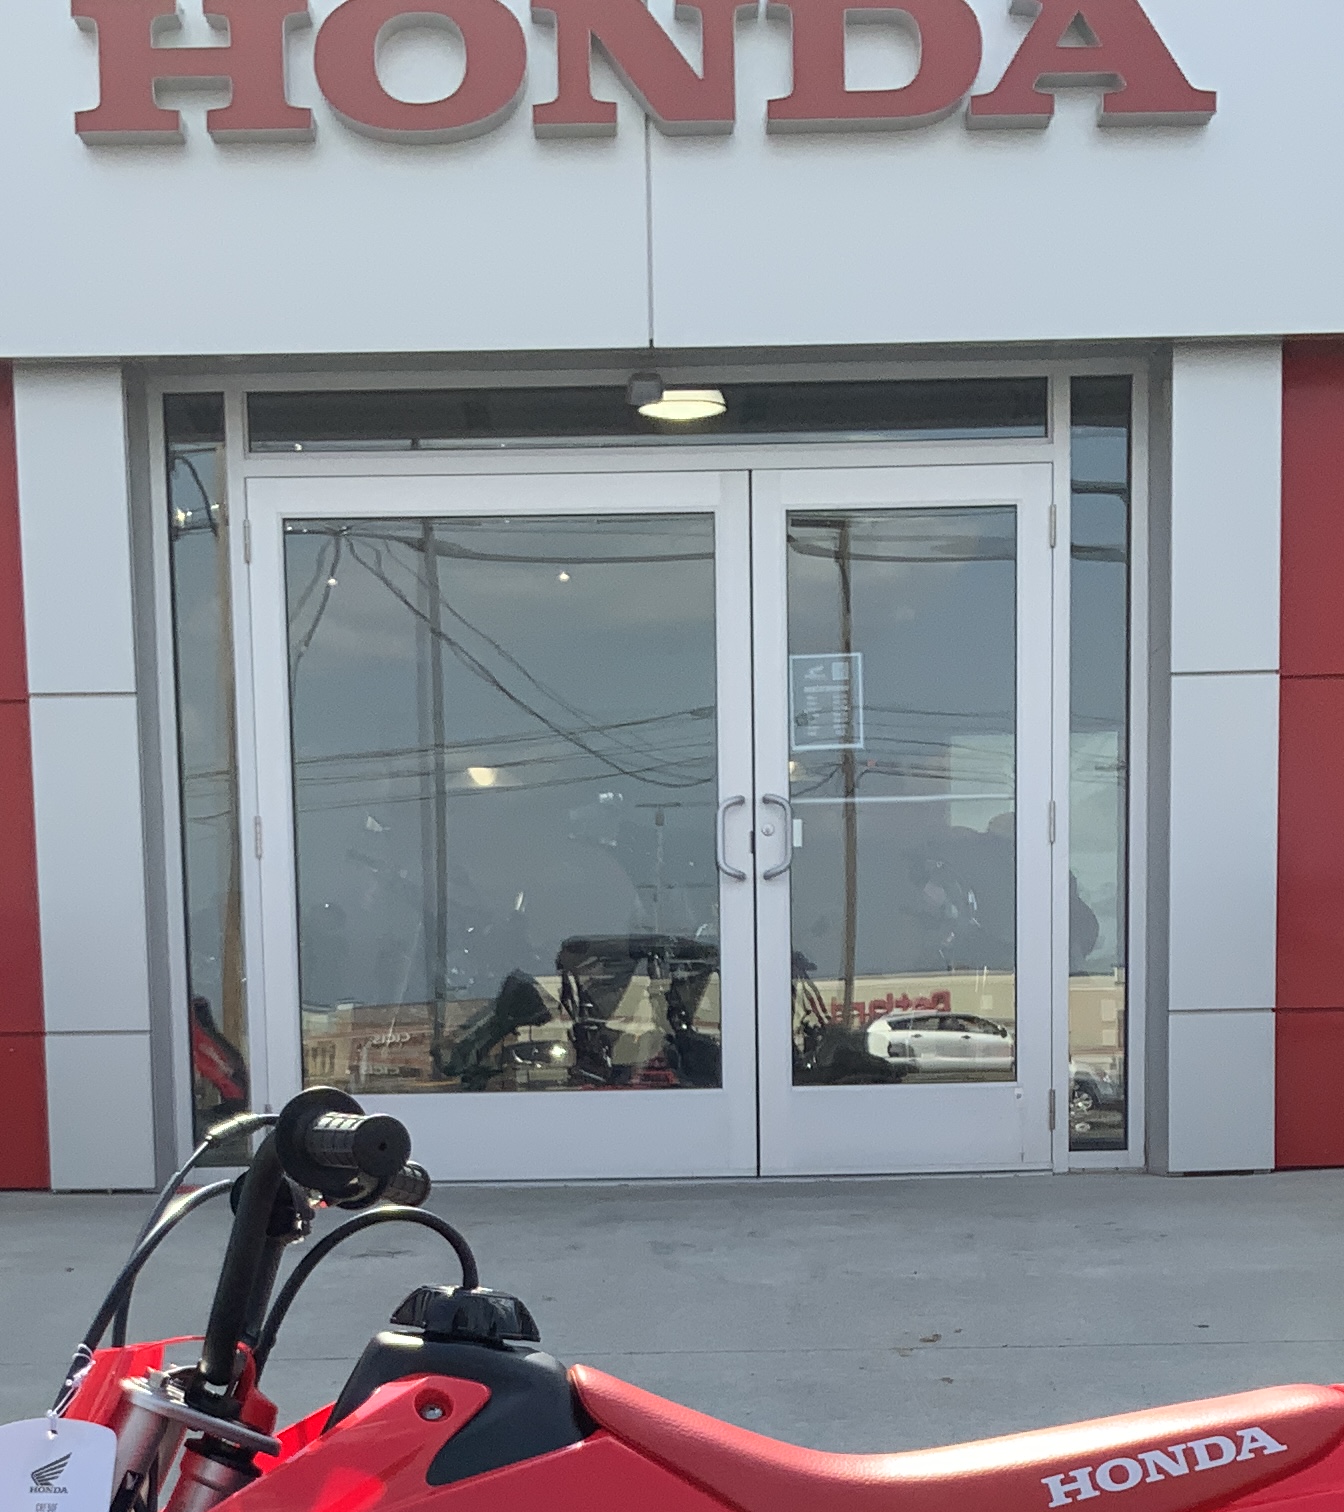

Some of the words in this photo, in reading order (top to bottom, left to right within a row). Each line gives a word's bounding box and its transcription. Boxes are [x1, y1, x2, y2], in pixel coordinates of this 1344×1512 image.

[74, 0, 1218, 143] HONDA
[29, 1486, 69, 1494] HONDA
[1041, 1426, 1288, 1508] HONDA
